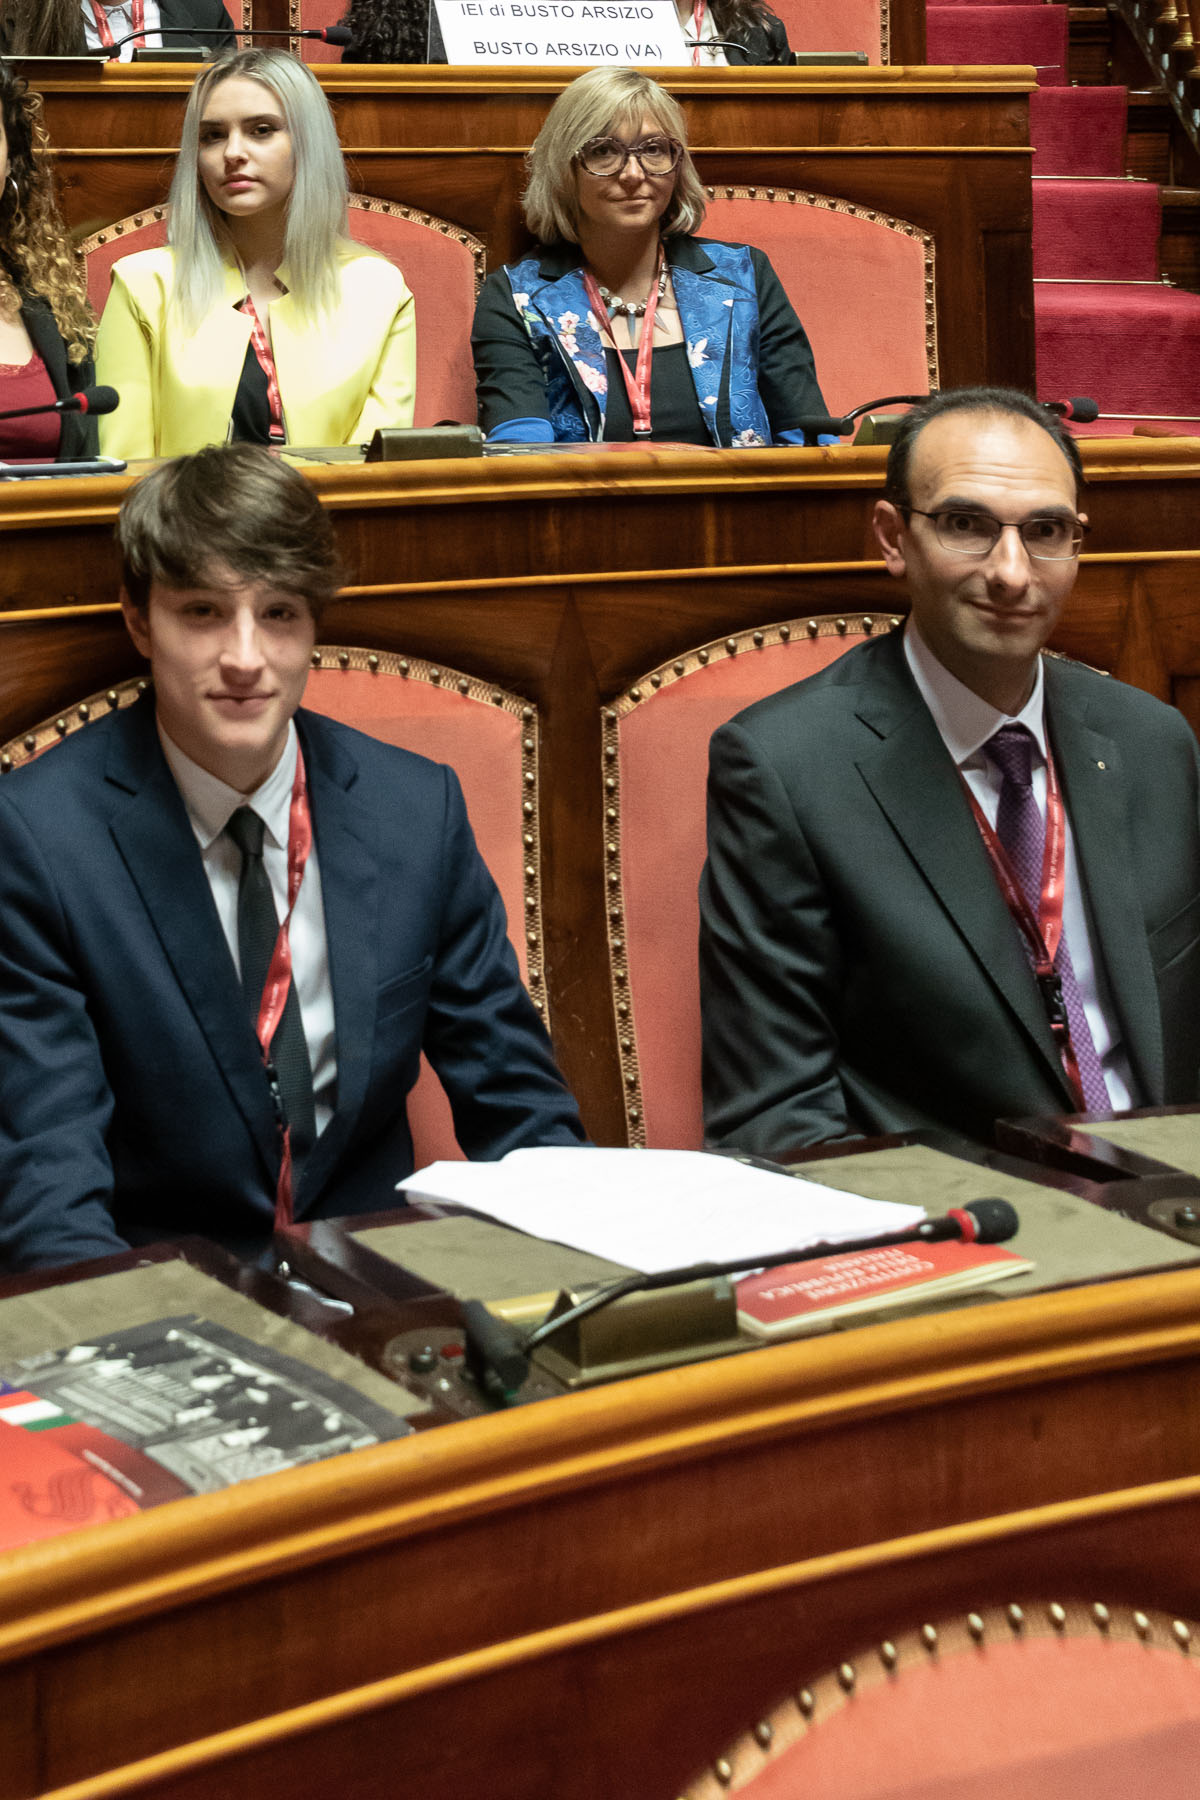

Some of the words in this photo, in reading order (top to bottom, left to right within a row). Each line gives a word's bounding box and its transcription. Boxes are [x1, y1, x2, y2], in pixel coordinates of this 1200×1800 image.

[460, 3, 484, 16] IEI
[489, 4, 505, 17] di
[511, 4, 574, 18] BUSTO
[581, 6, 654, 20] ARSIZIO
[473, 41, 539, 56] BUSTO
[545, 43, 619, 57] ARSIZIO
[625, 44, 663, 60] (VA)
